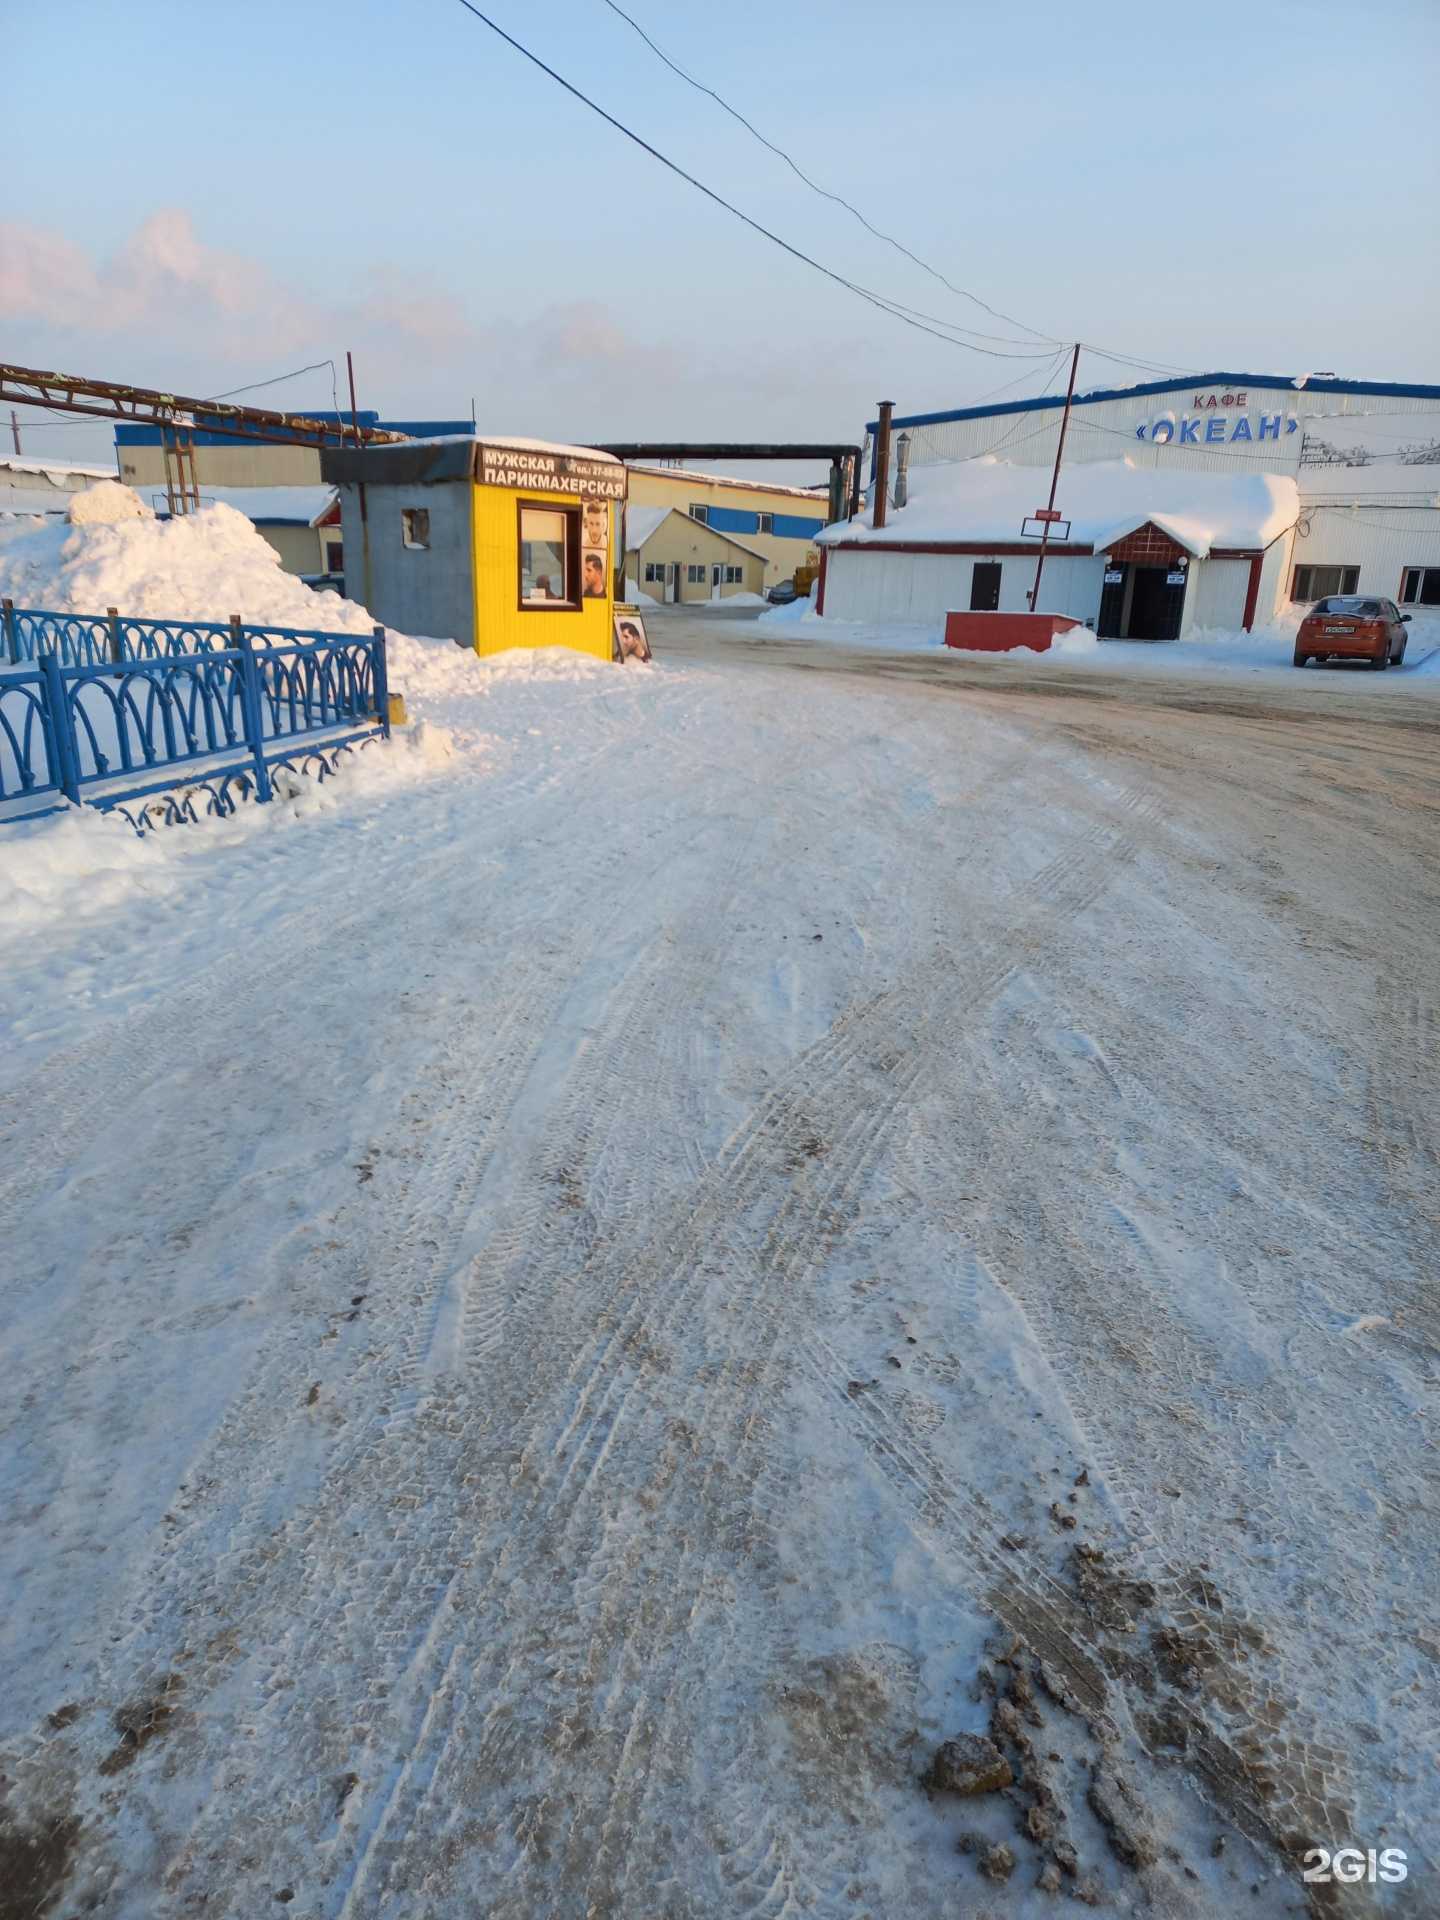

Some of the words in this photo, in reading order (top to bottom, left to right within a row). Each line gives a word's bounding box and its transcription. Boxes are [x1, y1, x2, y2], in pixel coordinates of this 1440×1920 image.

[1193, 393, 1247, 409] КАФЕ
[1136, 415, 1298, 444] «ОКЕАН»
[485, 451, 555, 472] МУЖСКАЯ
[484, 468, 624, 497] ПАРИКМАХЕРСКАЯ
